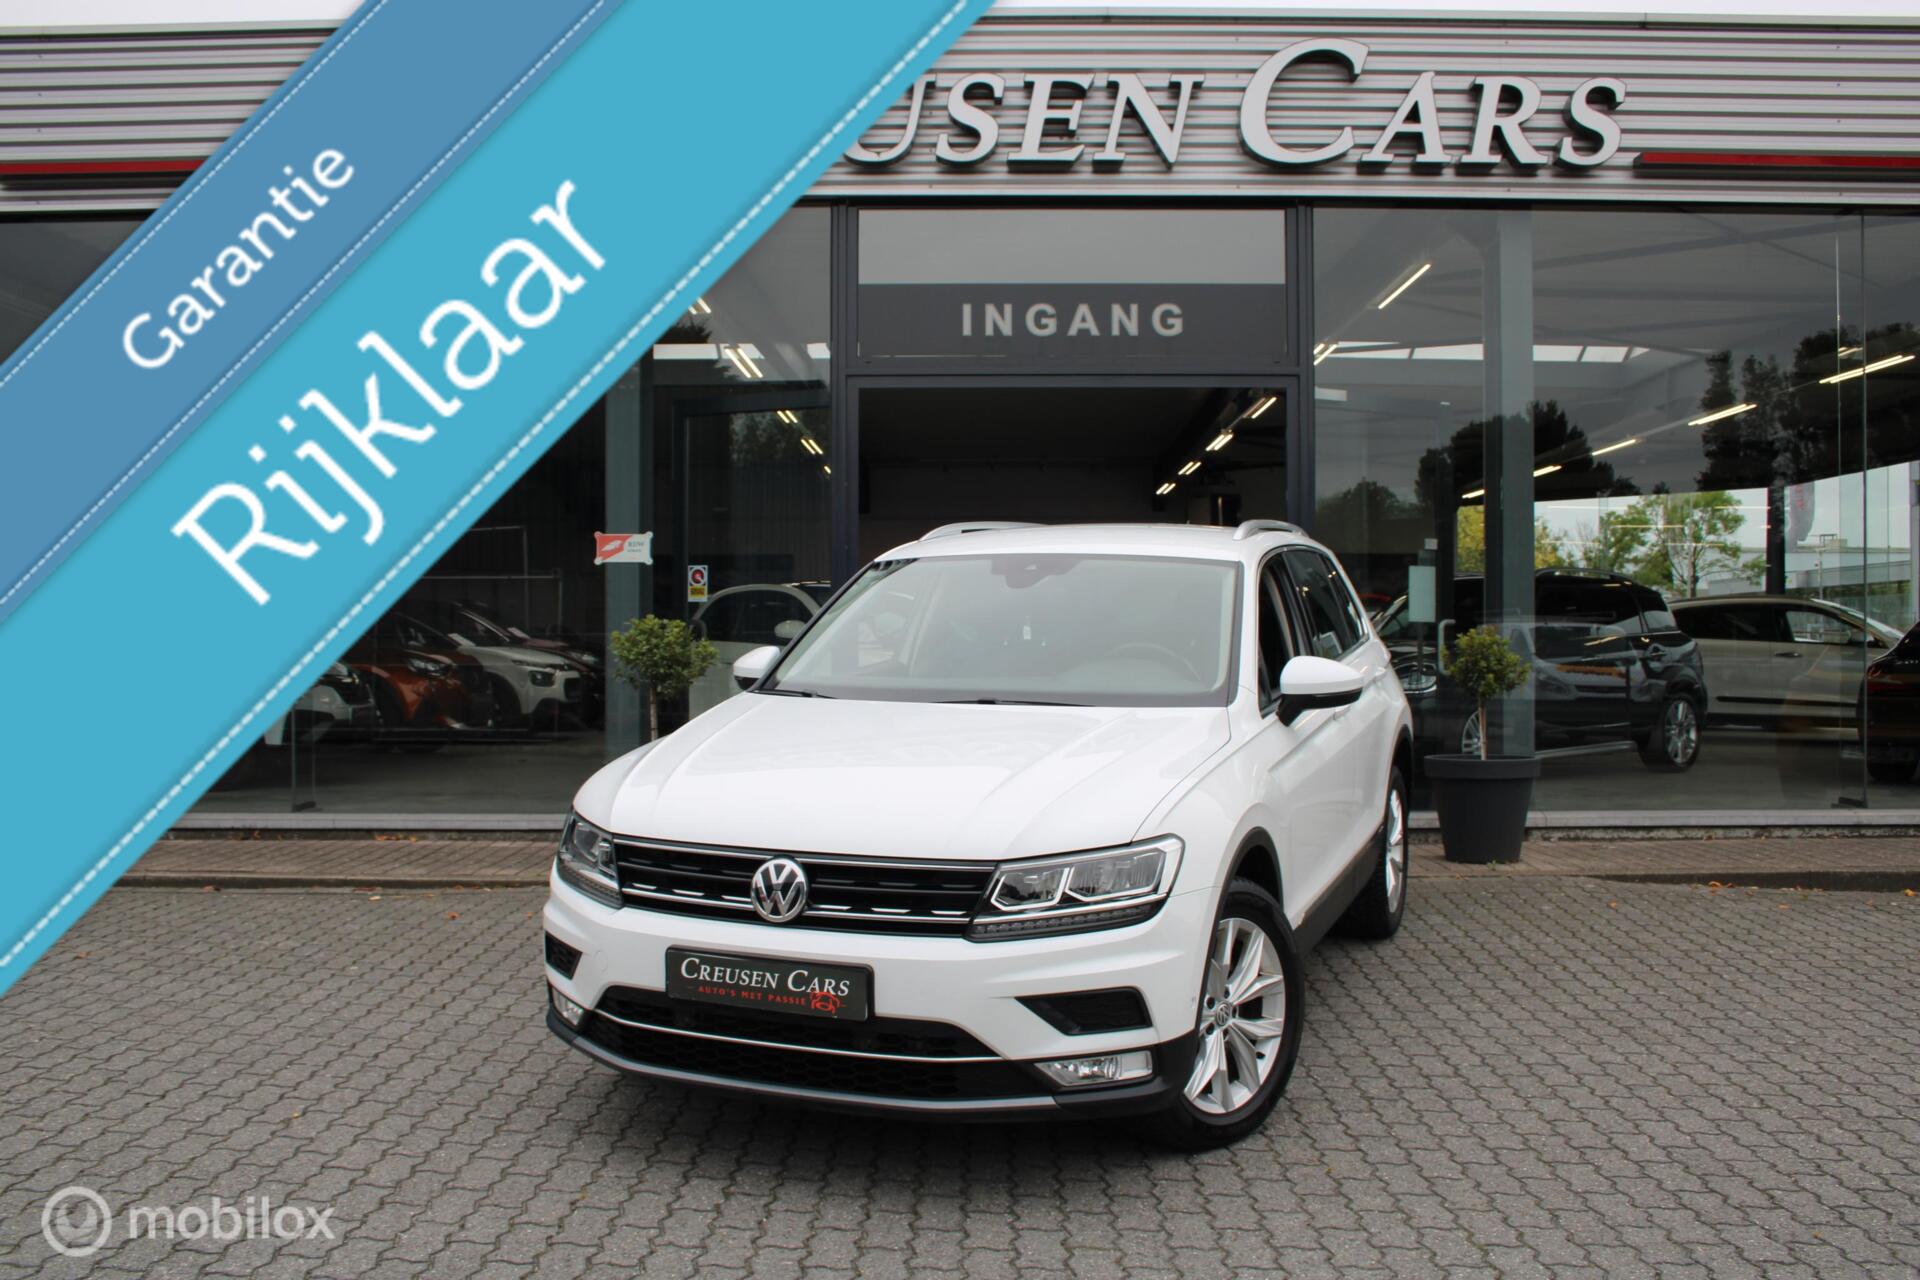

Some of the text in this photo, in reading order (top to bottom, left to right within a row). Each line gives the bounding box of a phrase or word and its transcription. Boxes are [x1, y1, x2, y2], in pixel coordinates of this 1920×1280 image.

[1239, 37, 1627, 168] CARS
[961, 302, 1186, 337] INGANG
[681, 957, 850, 996] CREUSEN CARS
[698, 985, 736, 997] AUTO'S
[741, 991, 764, 1001] MET
